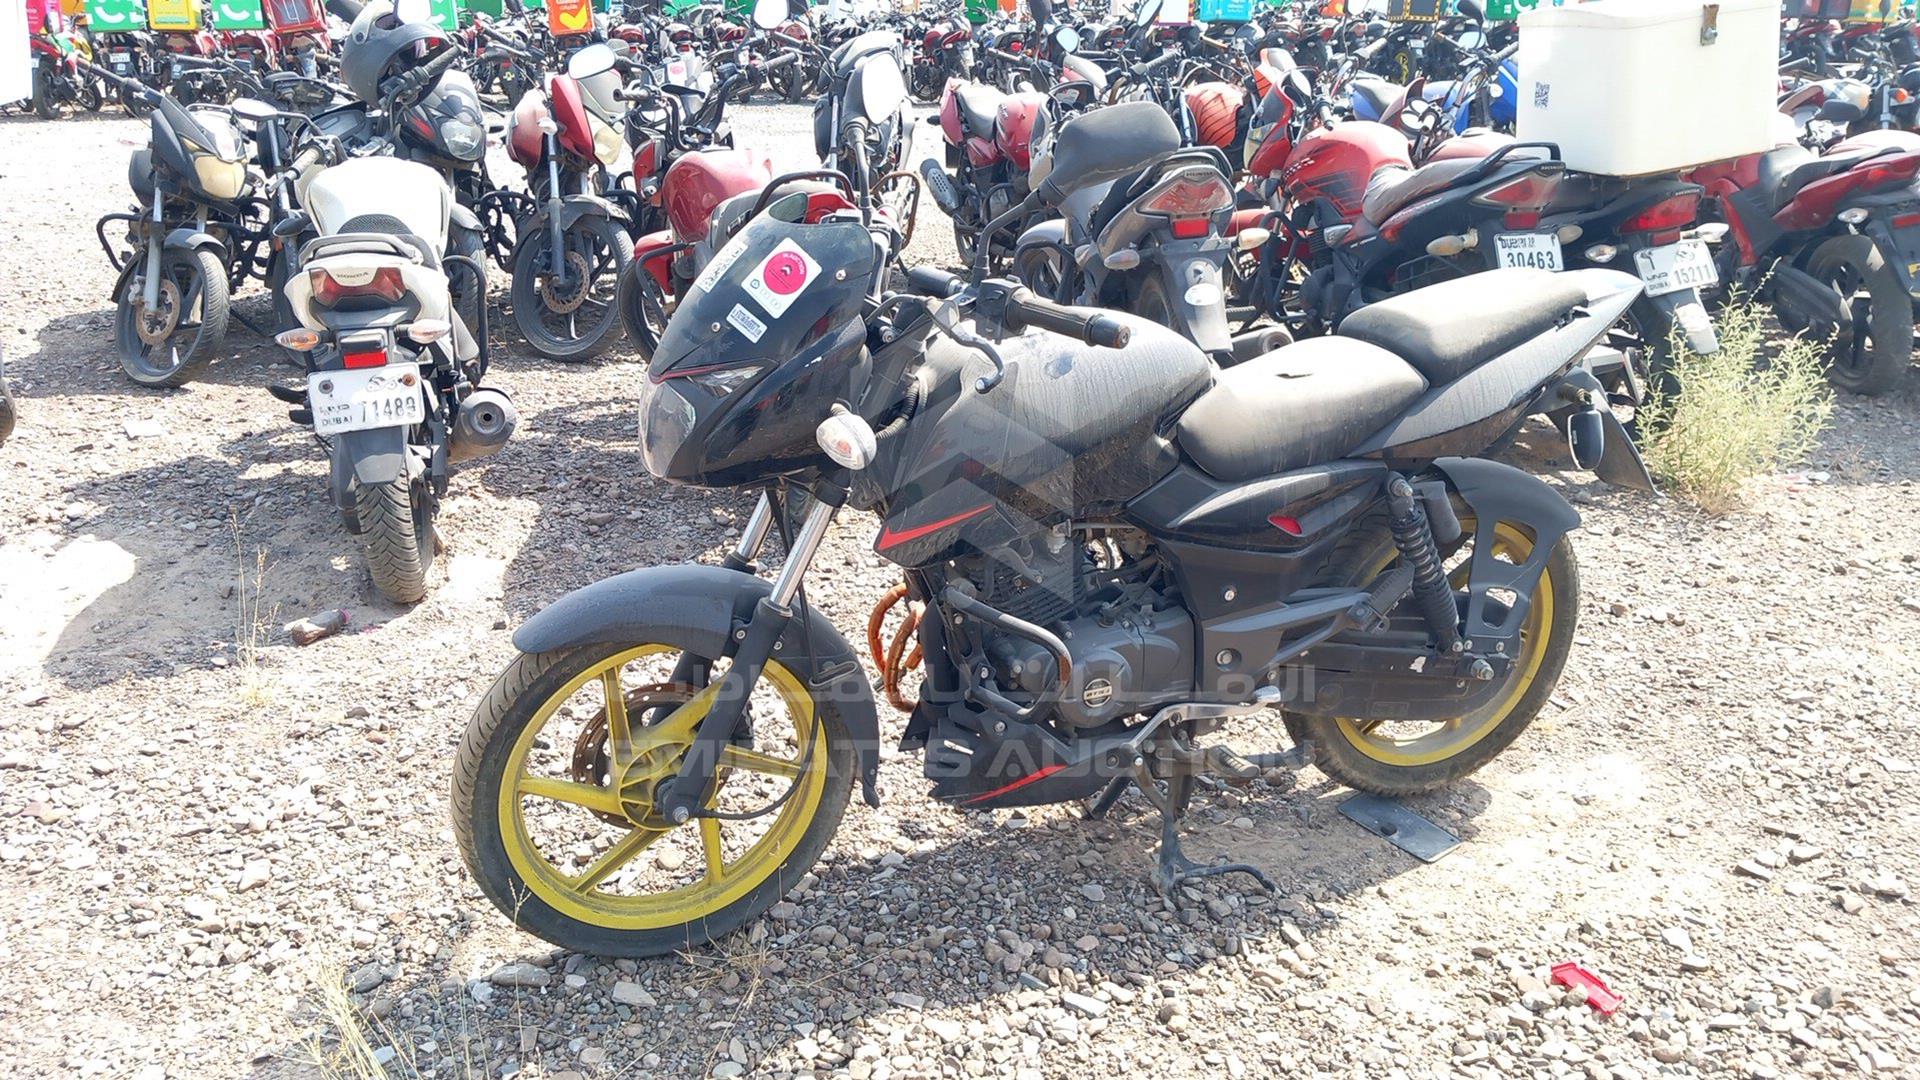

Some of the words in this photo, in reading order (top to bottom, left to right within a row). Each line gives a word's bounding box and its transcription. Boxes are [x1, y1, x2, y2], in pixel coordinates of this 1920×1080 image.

[1507, 250, 1555, 270] 30463
[1674, 263, 1711, 286] 15211
[321, 415, 353, 427] DUBAI
